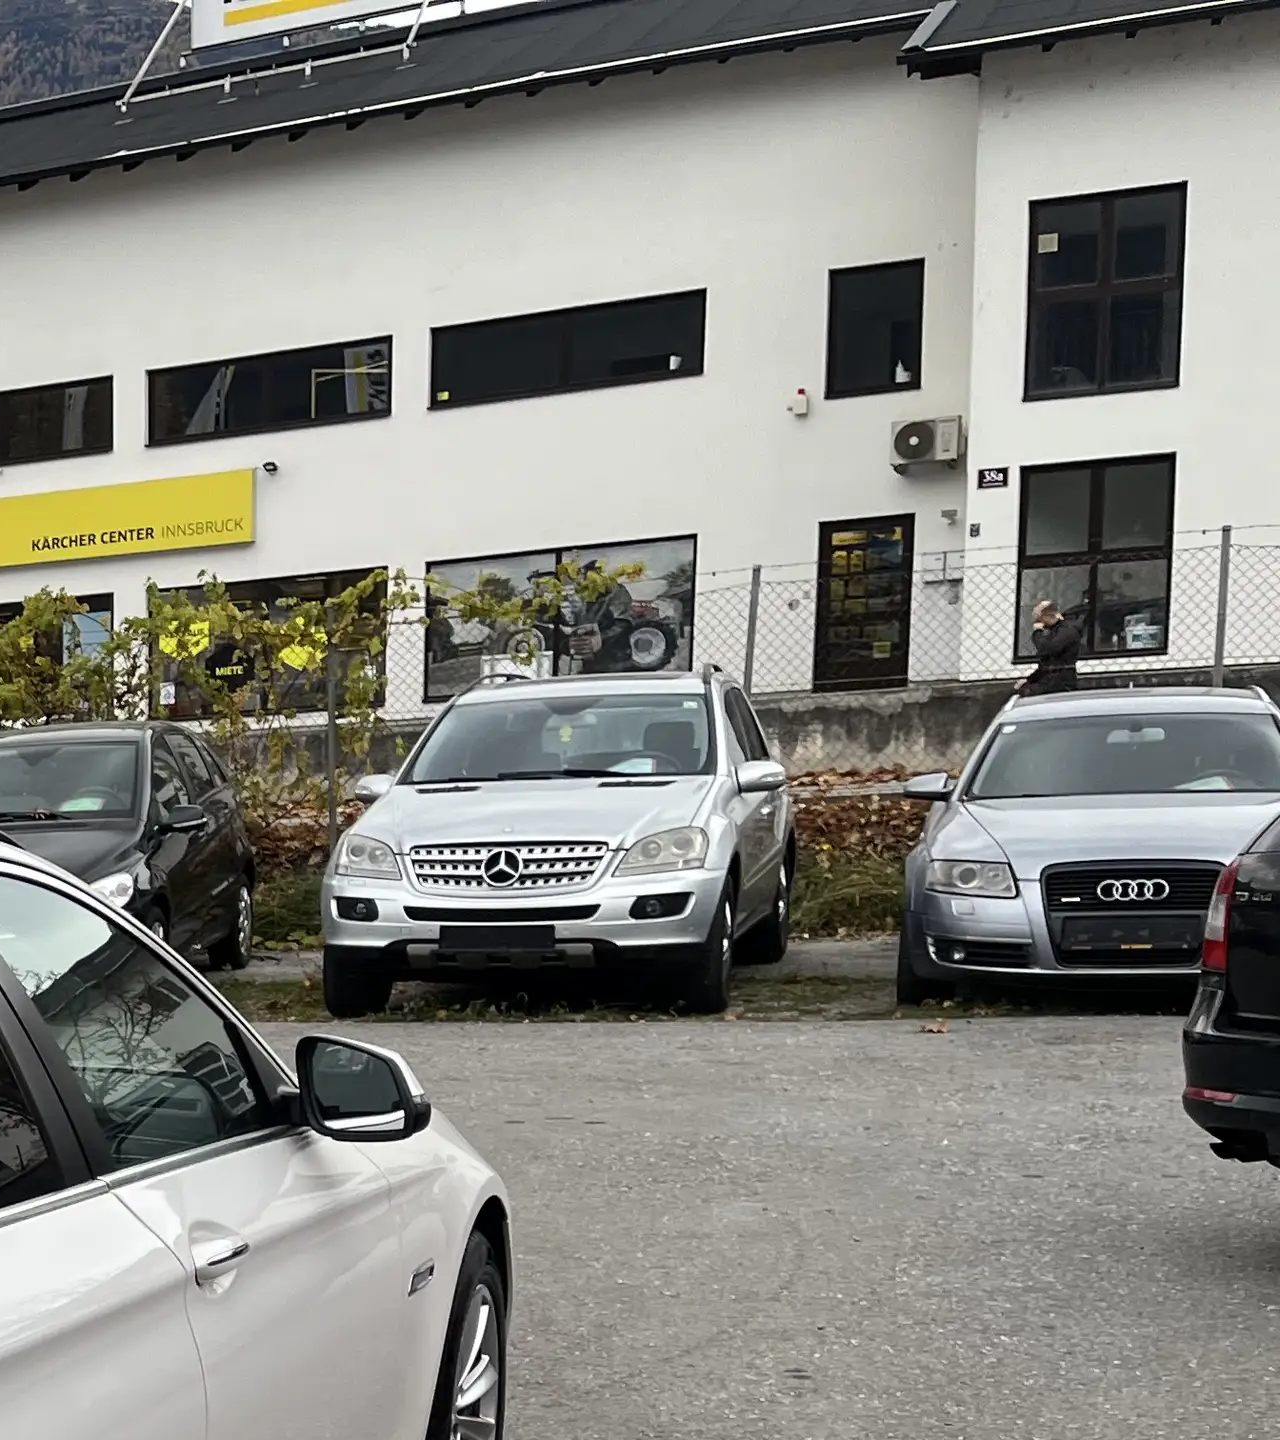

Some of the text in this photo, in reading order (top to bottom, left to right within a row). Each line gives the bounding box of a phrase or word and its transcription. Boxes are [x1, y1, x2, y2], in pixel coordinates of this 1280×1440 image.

[982, 470, 1004, 482] 38a
[31, 517, 244, 552] KÄRCHER CENTER INNSBRUCK
